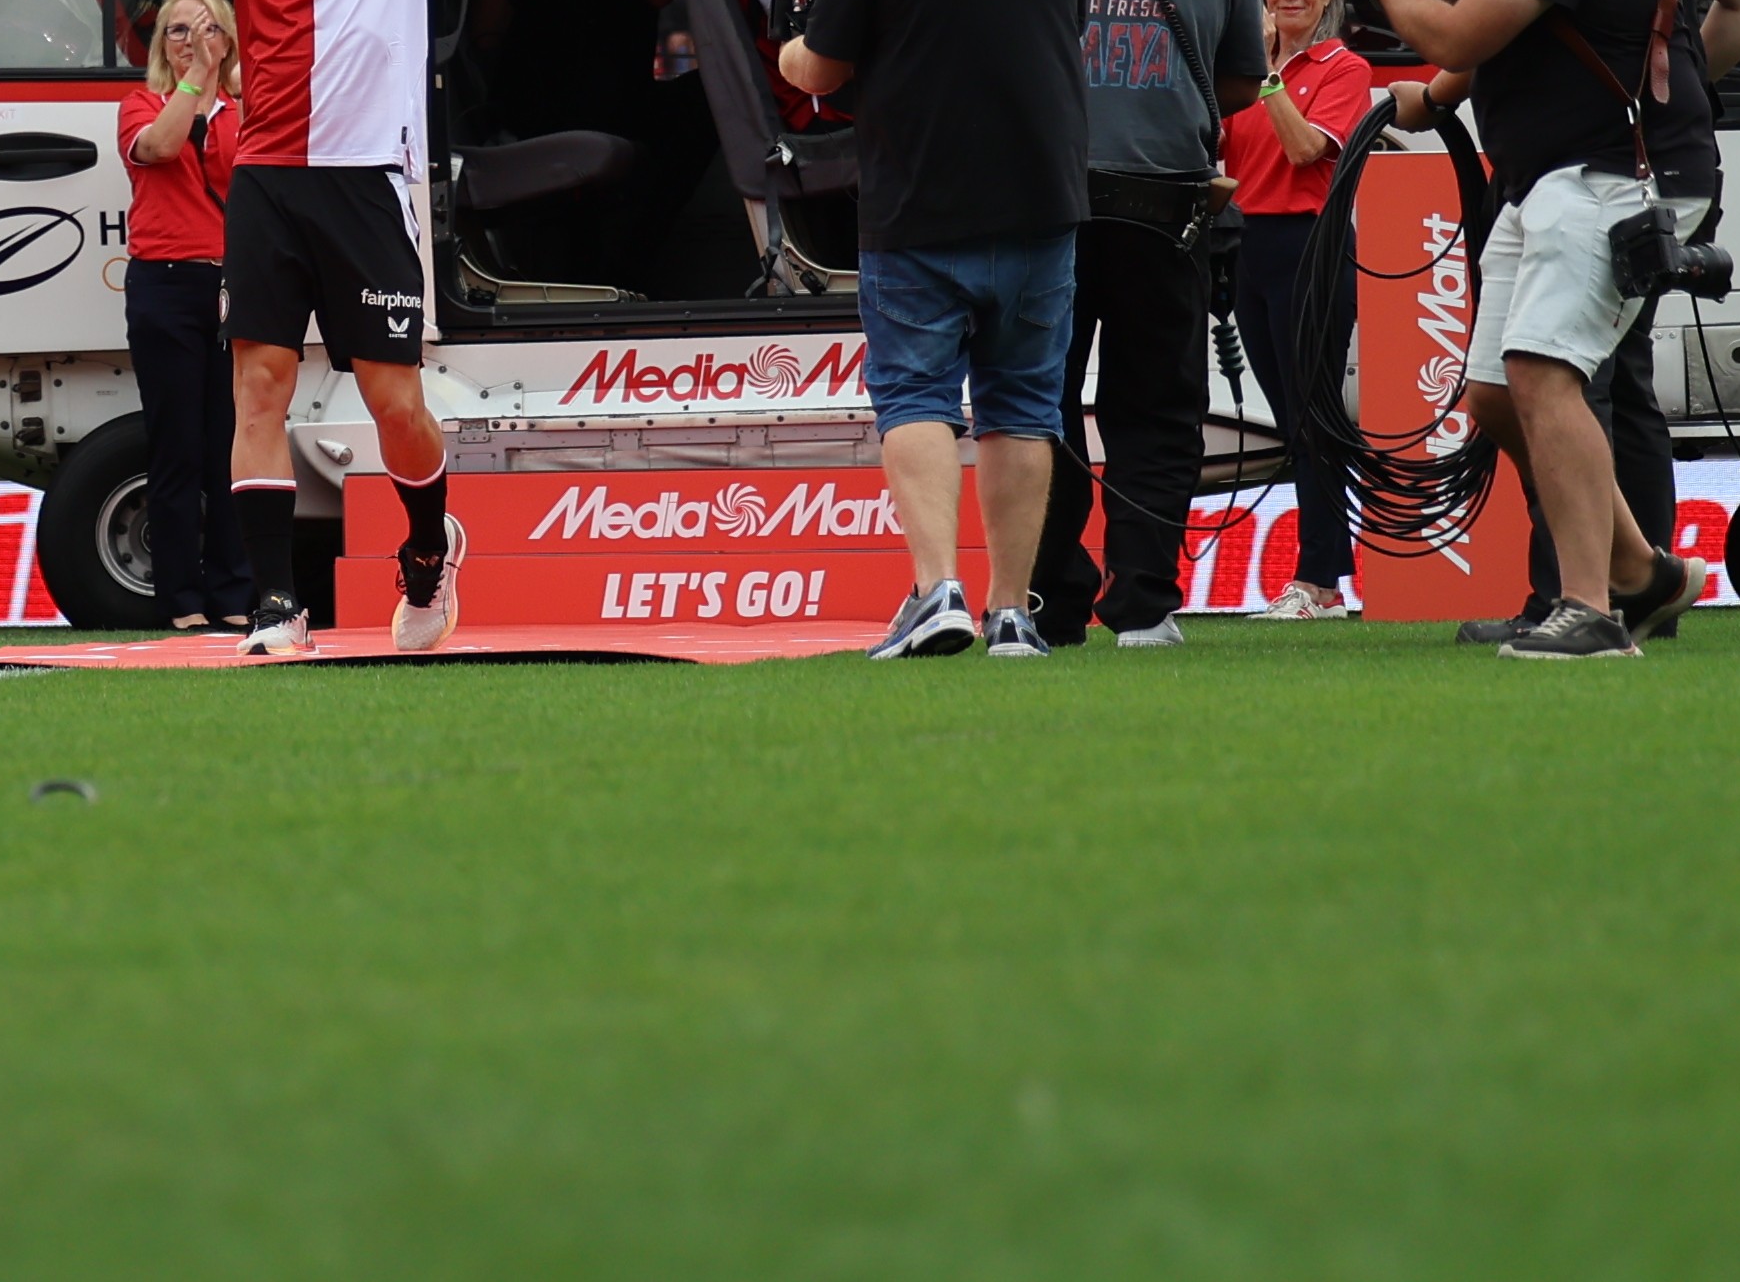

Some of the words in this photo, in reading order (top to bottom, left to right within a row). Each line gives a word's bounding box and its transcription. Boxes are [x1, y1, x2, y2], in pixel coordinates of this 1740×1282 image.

[361, 288, 421, 311] fairphone
[558, 347, 748, 406] Media
[528, 485, 710, 541] Media
[756, 482, 907, 536] Mark
[735, 569, 826, 618] GO!
